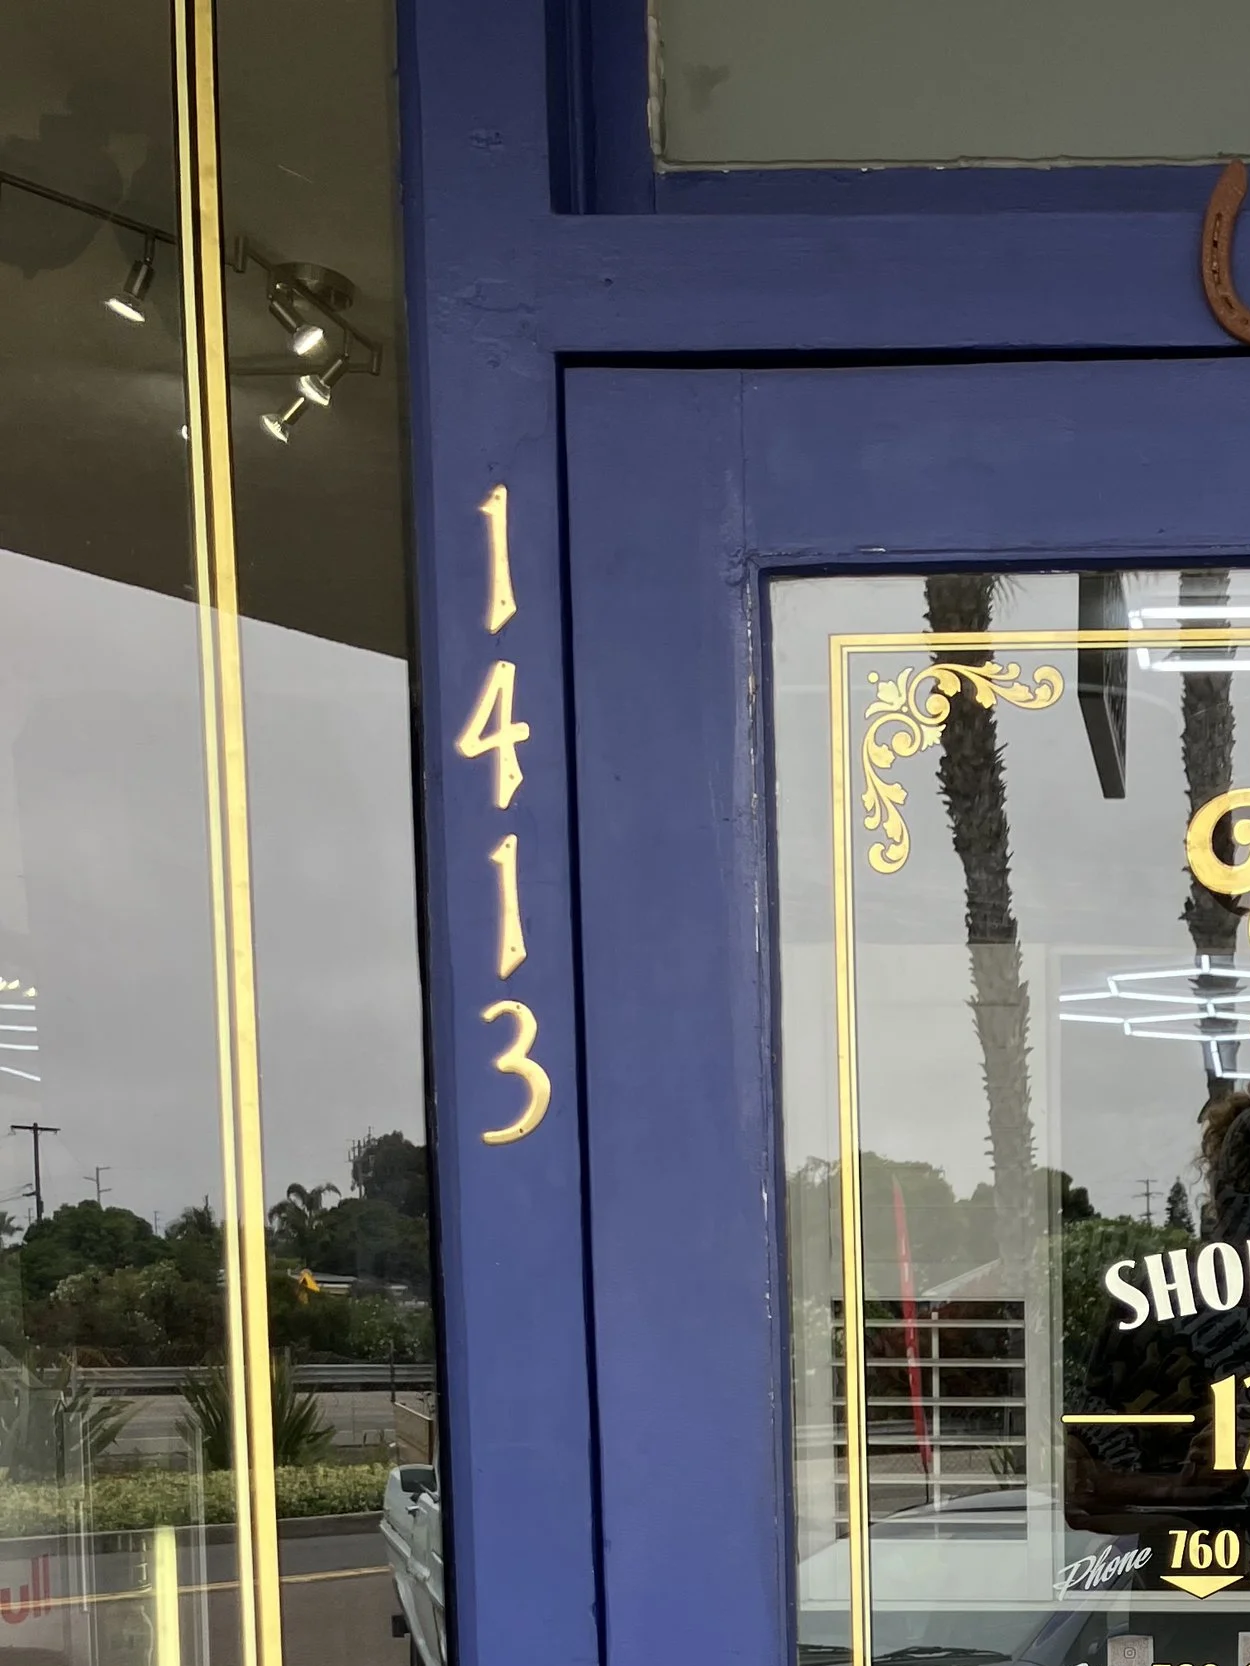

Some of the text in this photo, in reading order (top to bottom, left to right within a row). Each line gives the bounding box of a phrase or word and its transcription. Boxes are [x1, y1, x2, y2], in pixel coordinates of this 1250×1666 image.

[456, 484, 551, 1145] 1413
[1053, 1547, 1153, 1602] Phone
[1168, 1529, 1241, 1570] 760
